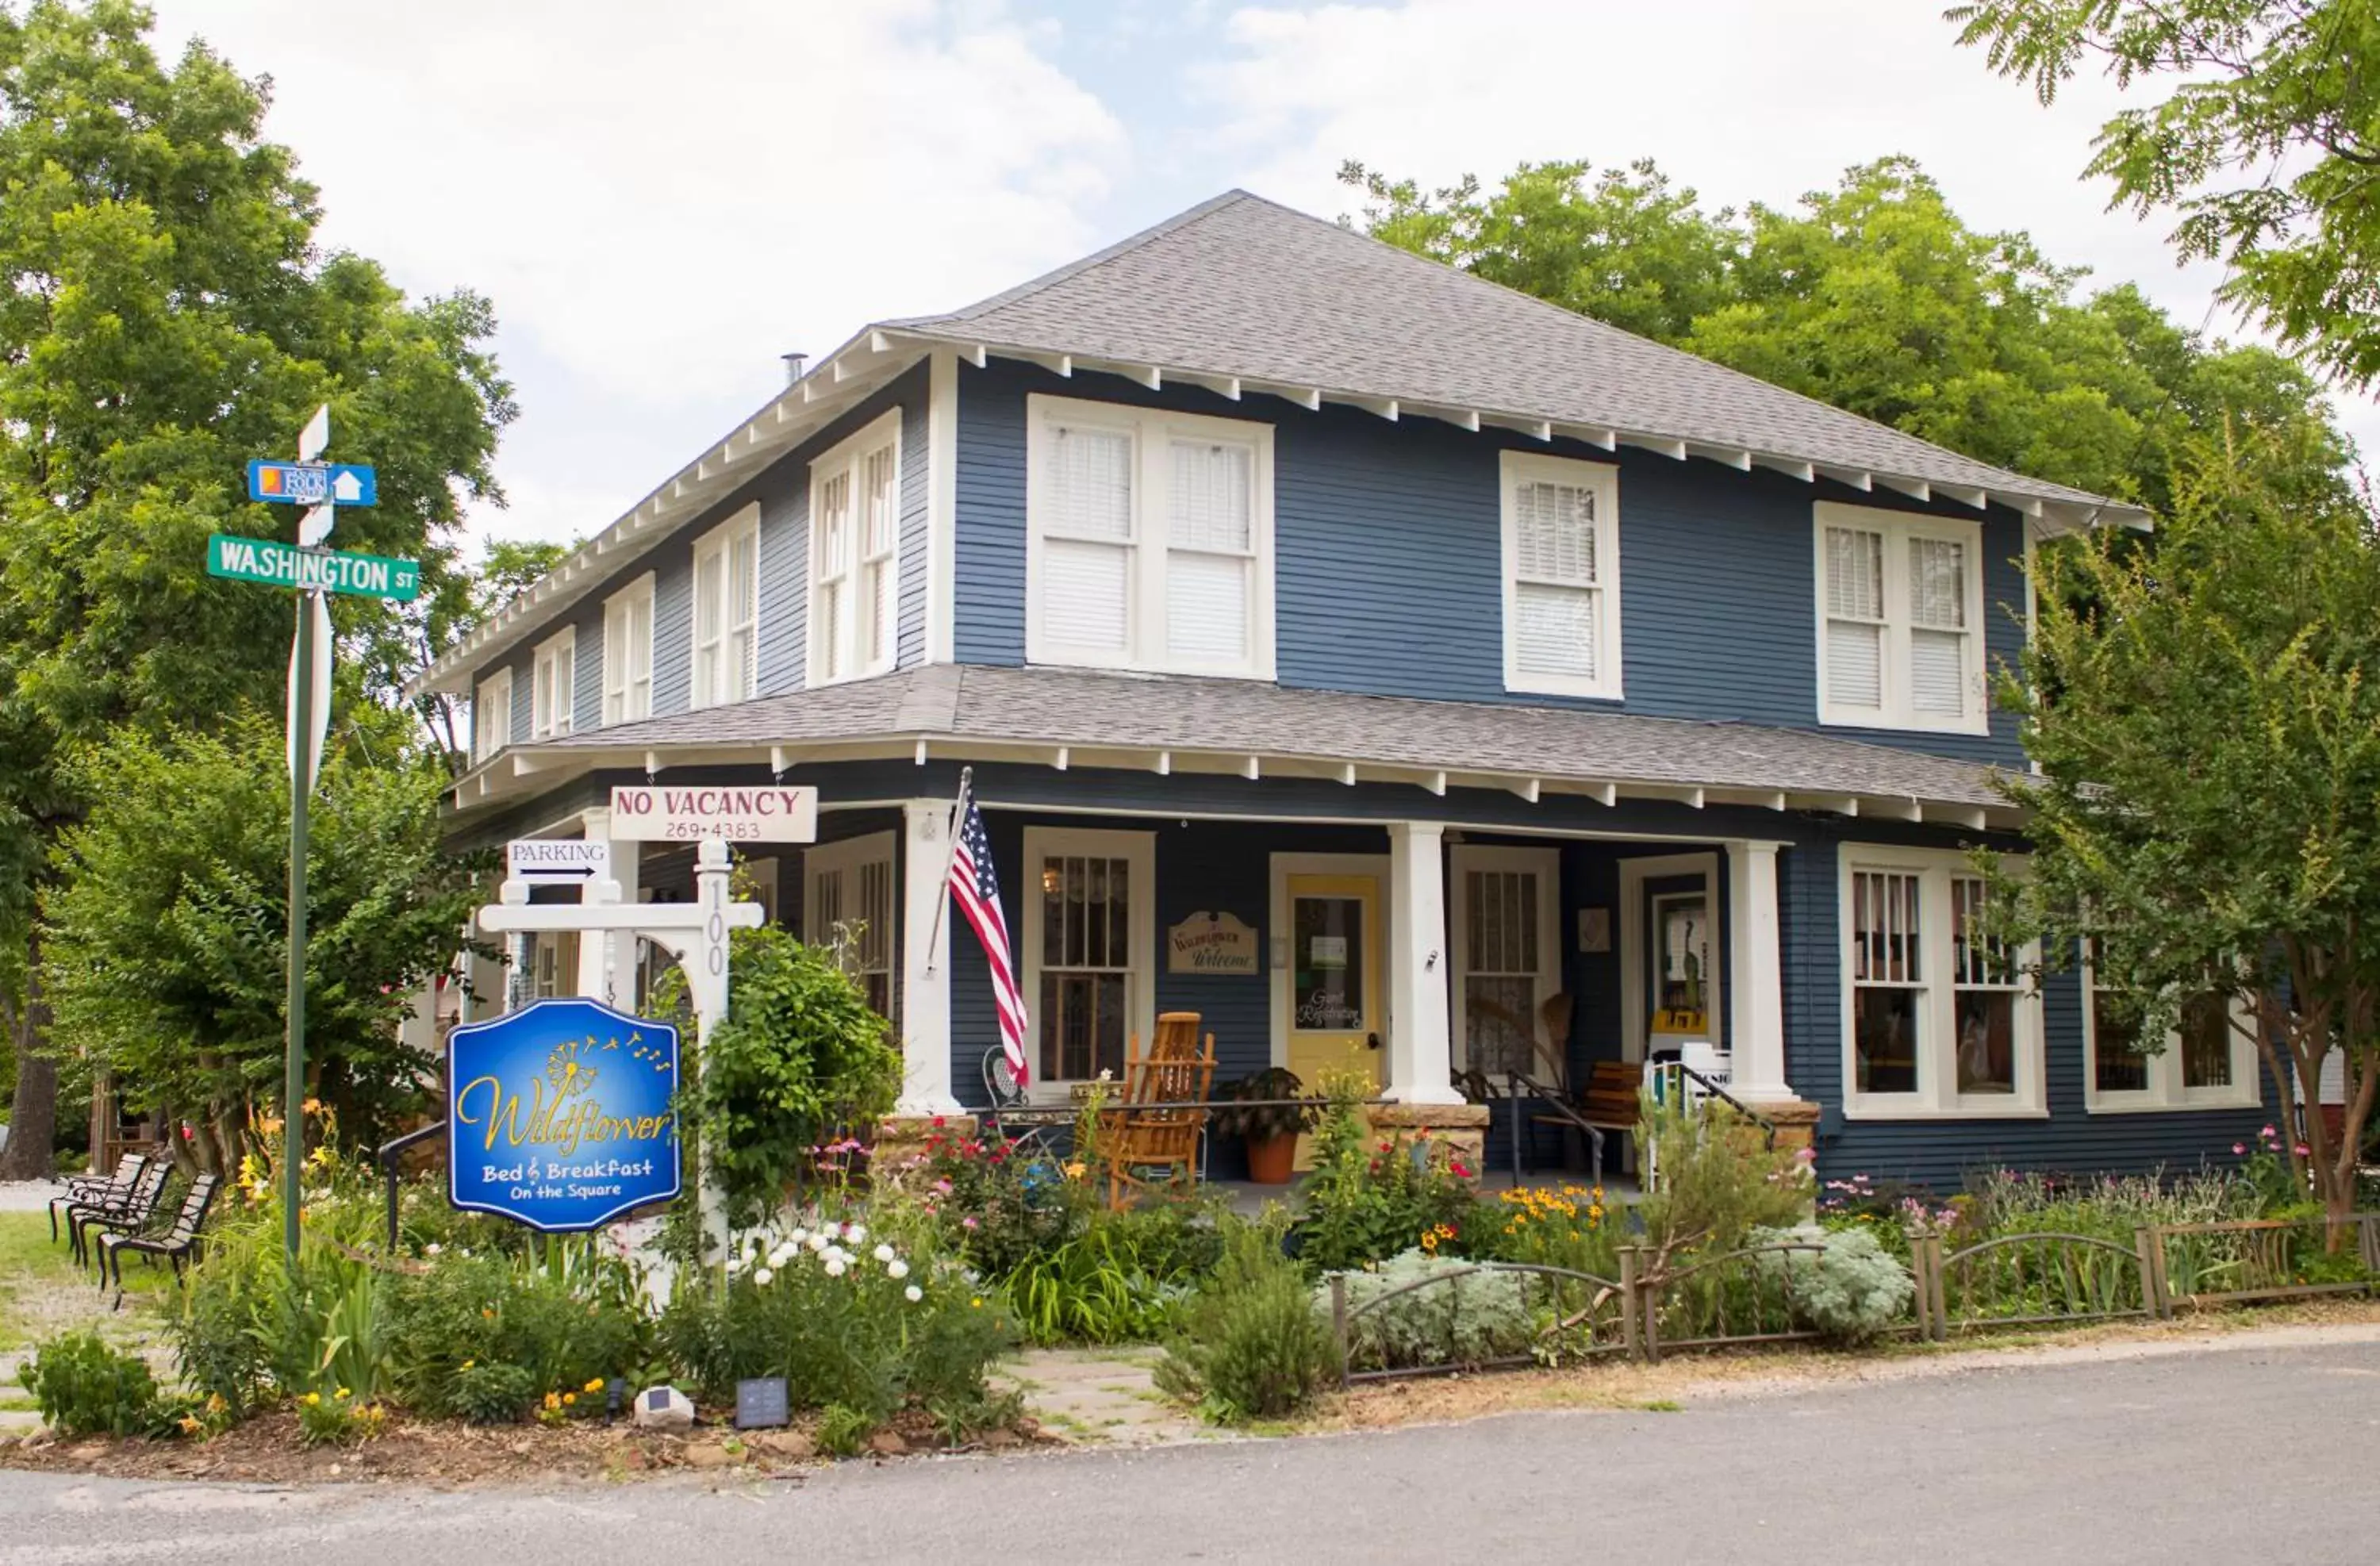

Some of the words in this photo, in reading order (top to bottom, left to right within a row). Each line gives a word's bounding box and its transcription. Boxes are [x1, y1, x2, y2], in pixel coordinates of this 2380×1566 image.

[220, 541, 390, 592] WASHINGTON
[396, 573, 415, 589] ST
[616, 792, 654, 816] NO
[665, 791, 800, 816] VACANCY
[512, 844, 605, 862] PARKING
[456, 1075, 670, 1157] Wildflower
[482, 1164, 524, 1183] Bed
[547, 1158, 654, 1180] Breakfast
[510, 1185, 532, 1200] On
[536, 1184, 563, 1199] the
[568, 1181, 622, 1201] Square
